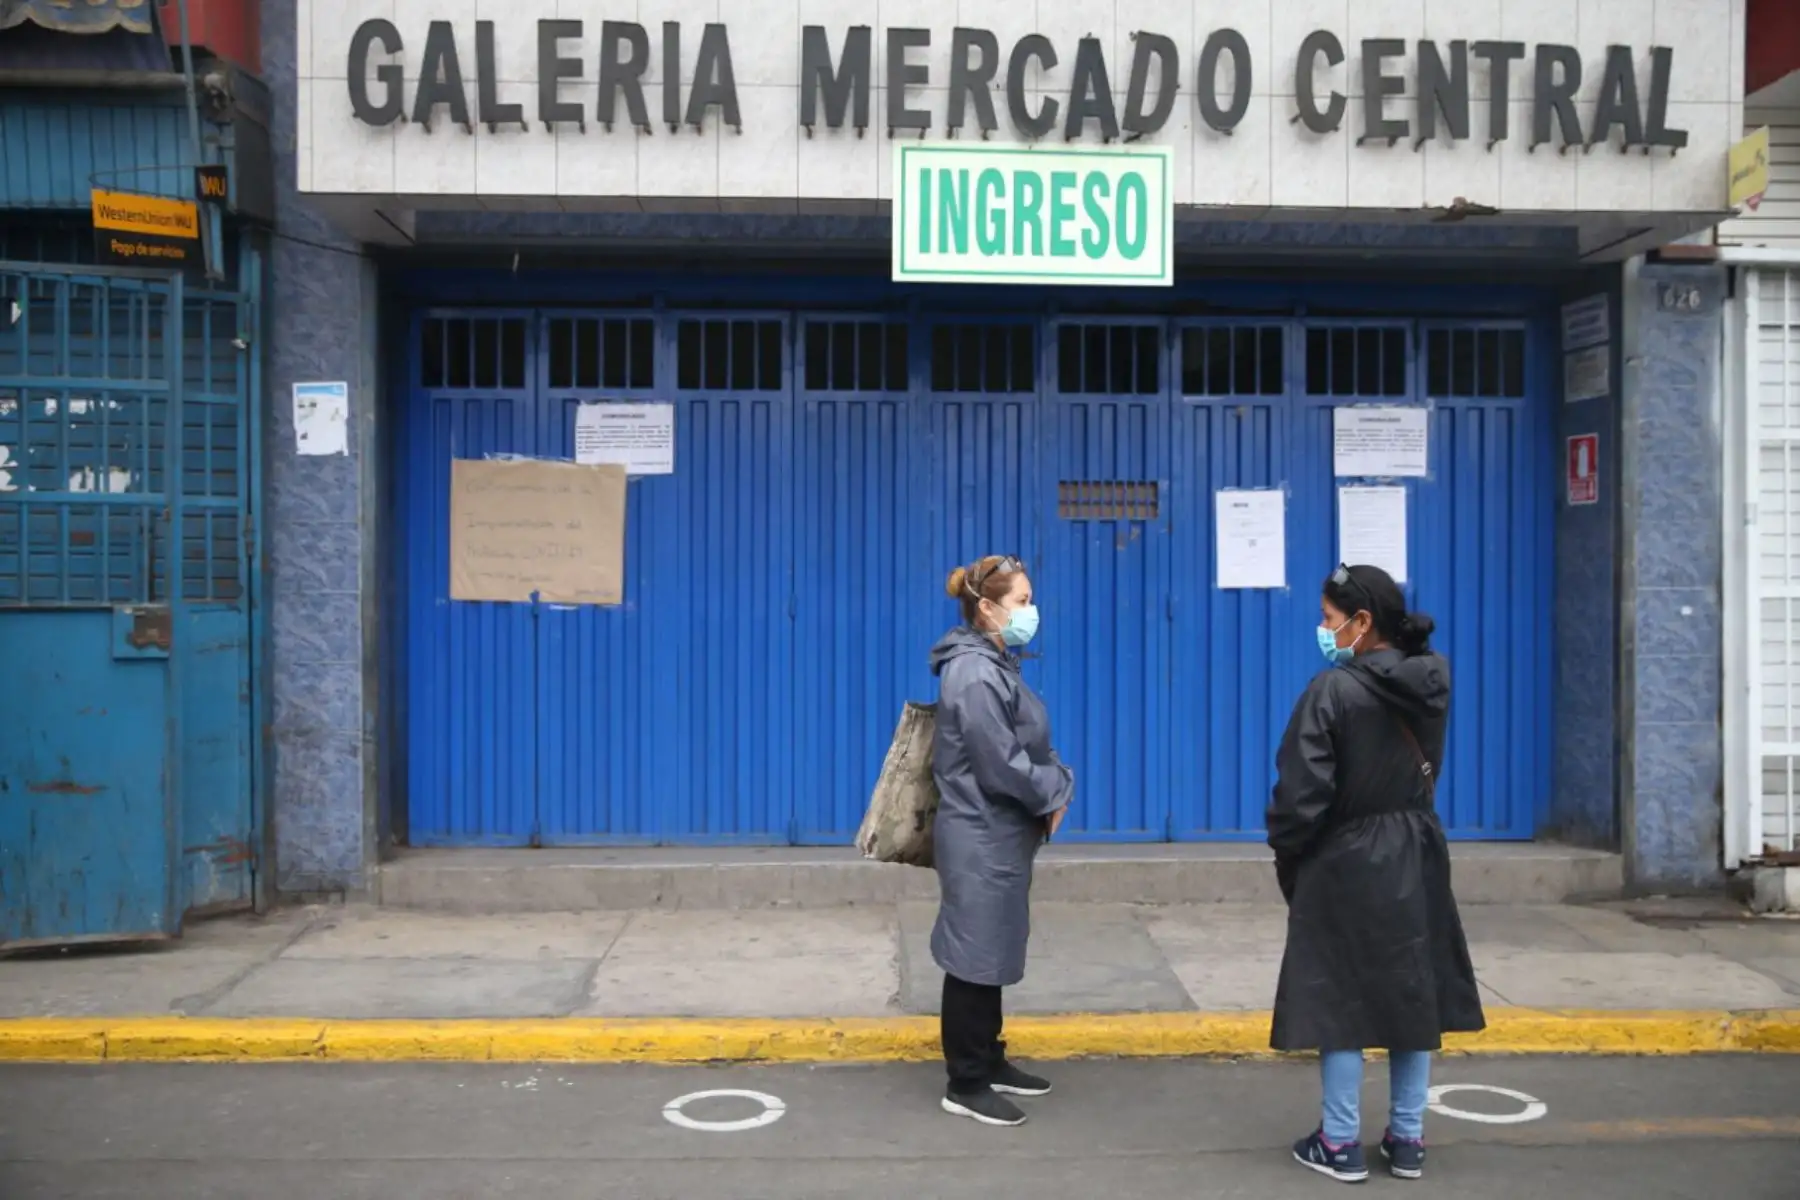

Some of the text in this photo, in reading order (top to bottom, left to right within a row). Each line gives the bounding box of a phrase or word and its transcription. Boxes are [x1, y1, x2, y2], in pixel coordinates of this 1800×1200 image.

[347, 18, 1689, 148] GALERIA MERCADO CENTRAL
[919, 167, 1148, 260] INGRESO
